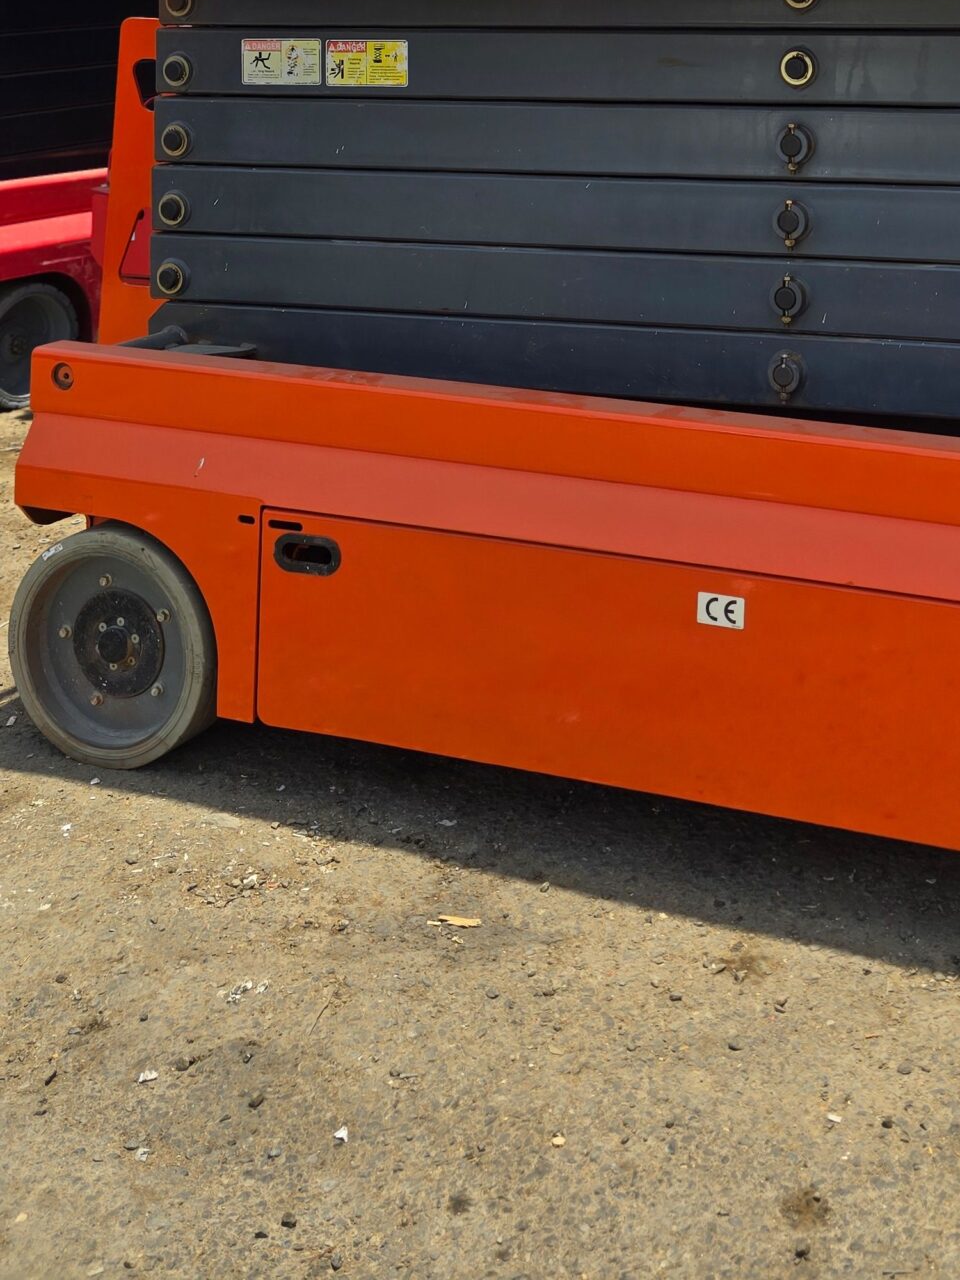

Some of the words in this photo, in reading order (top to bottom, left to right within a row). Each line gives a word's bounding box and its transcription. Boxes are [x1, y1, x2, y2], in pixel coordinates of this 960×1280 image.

[251, 41, 281, 51] DANGER
[336, 41, 367, 52] DANGER
[705, 596, 738, 625] CE
